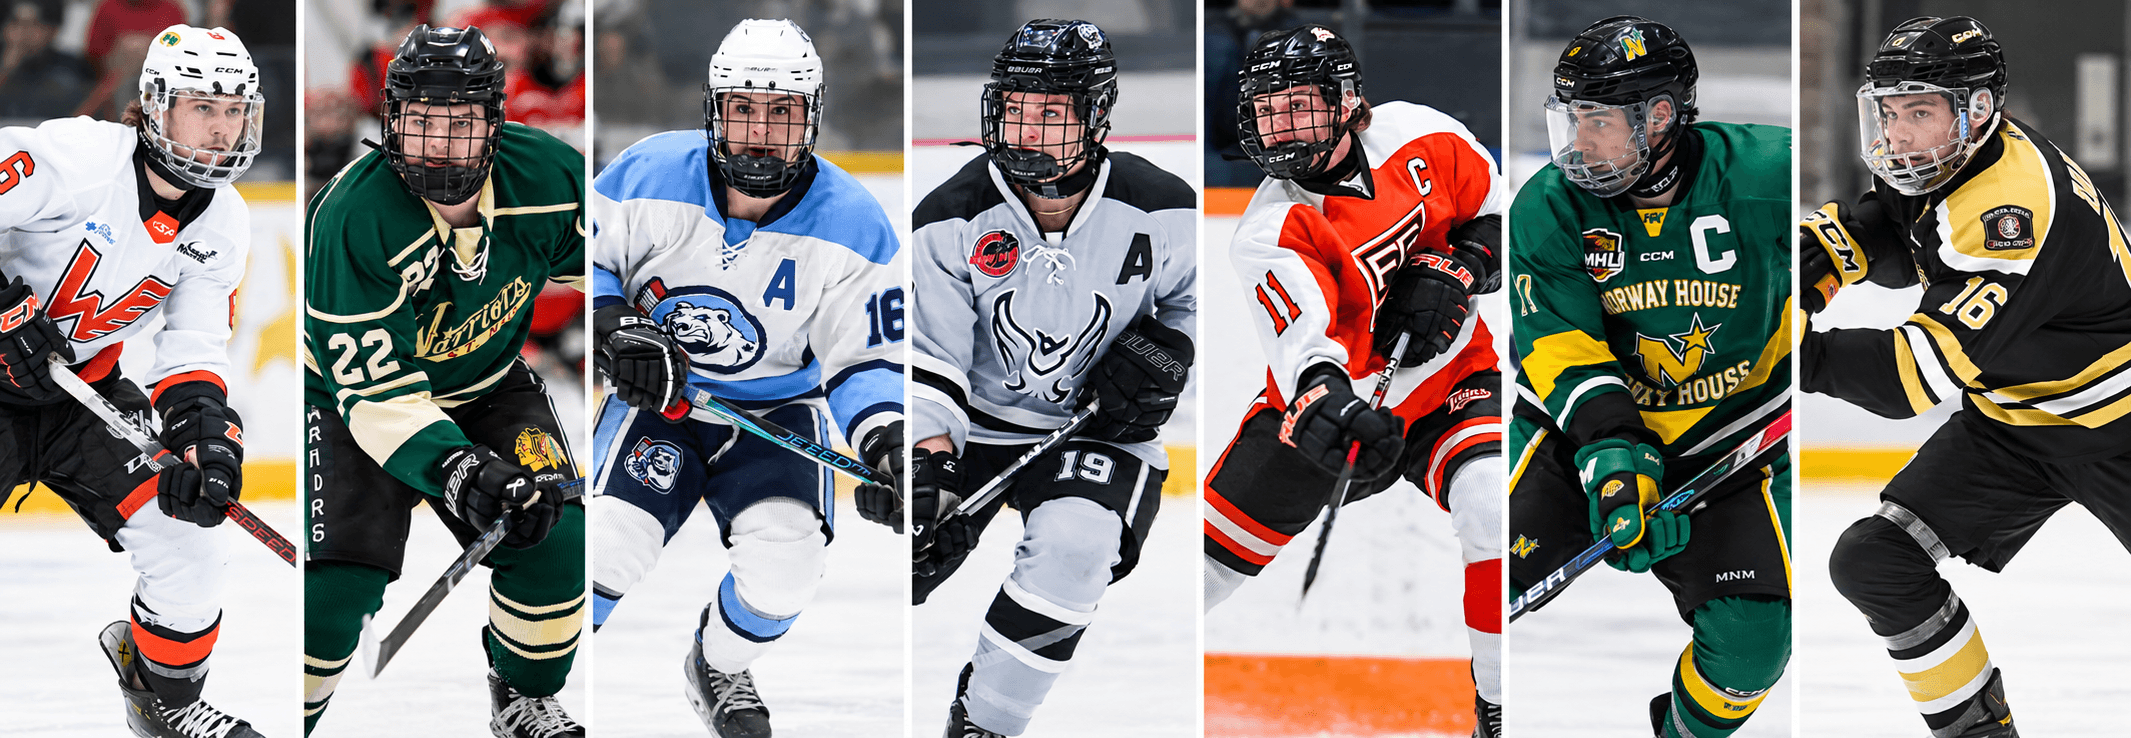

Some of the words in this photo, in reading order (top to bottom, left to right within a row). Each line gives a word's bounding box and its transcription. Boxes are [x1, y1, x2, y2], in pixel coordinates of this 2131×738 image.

[214, 66, 244, 75] CCM
[1251, 60, 1281, 73] CCM
[1556, 77, 1575, 88] CCM
[0, 150, 36, 195] 6
[1269, 152, 1296, 164] CCM
[1406, 156, 1433, 197] C
[1115, 232, 1154, 286] A
[1639, 250, 1675, 262] CCM
[1690, 214, 1738, 275] C
[762, 257, 796, 312] A
[1254, 269, 1303, 338] 11
[1600, 279, 1669, 315] NORWAY
[1673, 279, 1742, 309] HOUSE
[1938, 275, 2009, 330] 16
[864, 285, 904, 349] 16
[328, 328, 401, 386] 22
[1054, 450, 1117, 485] 19
[229, 506, 296, 562] SPEED
[1715, 570, 1756, 583] MNM
